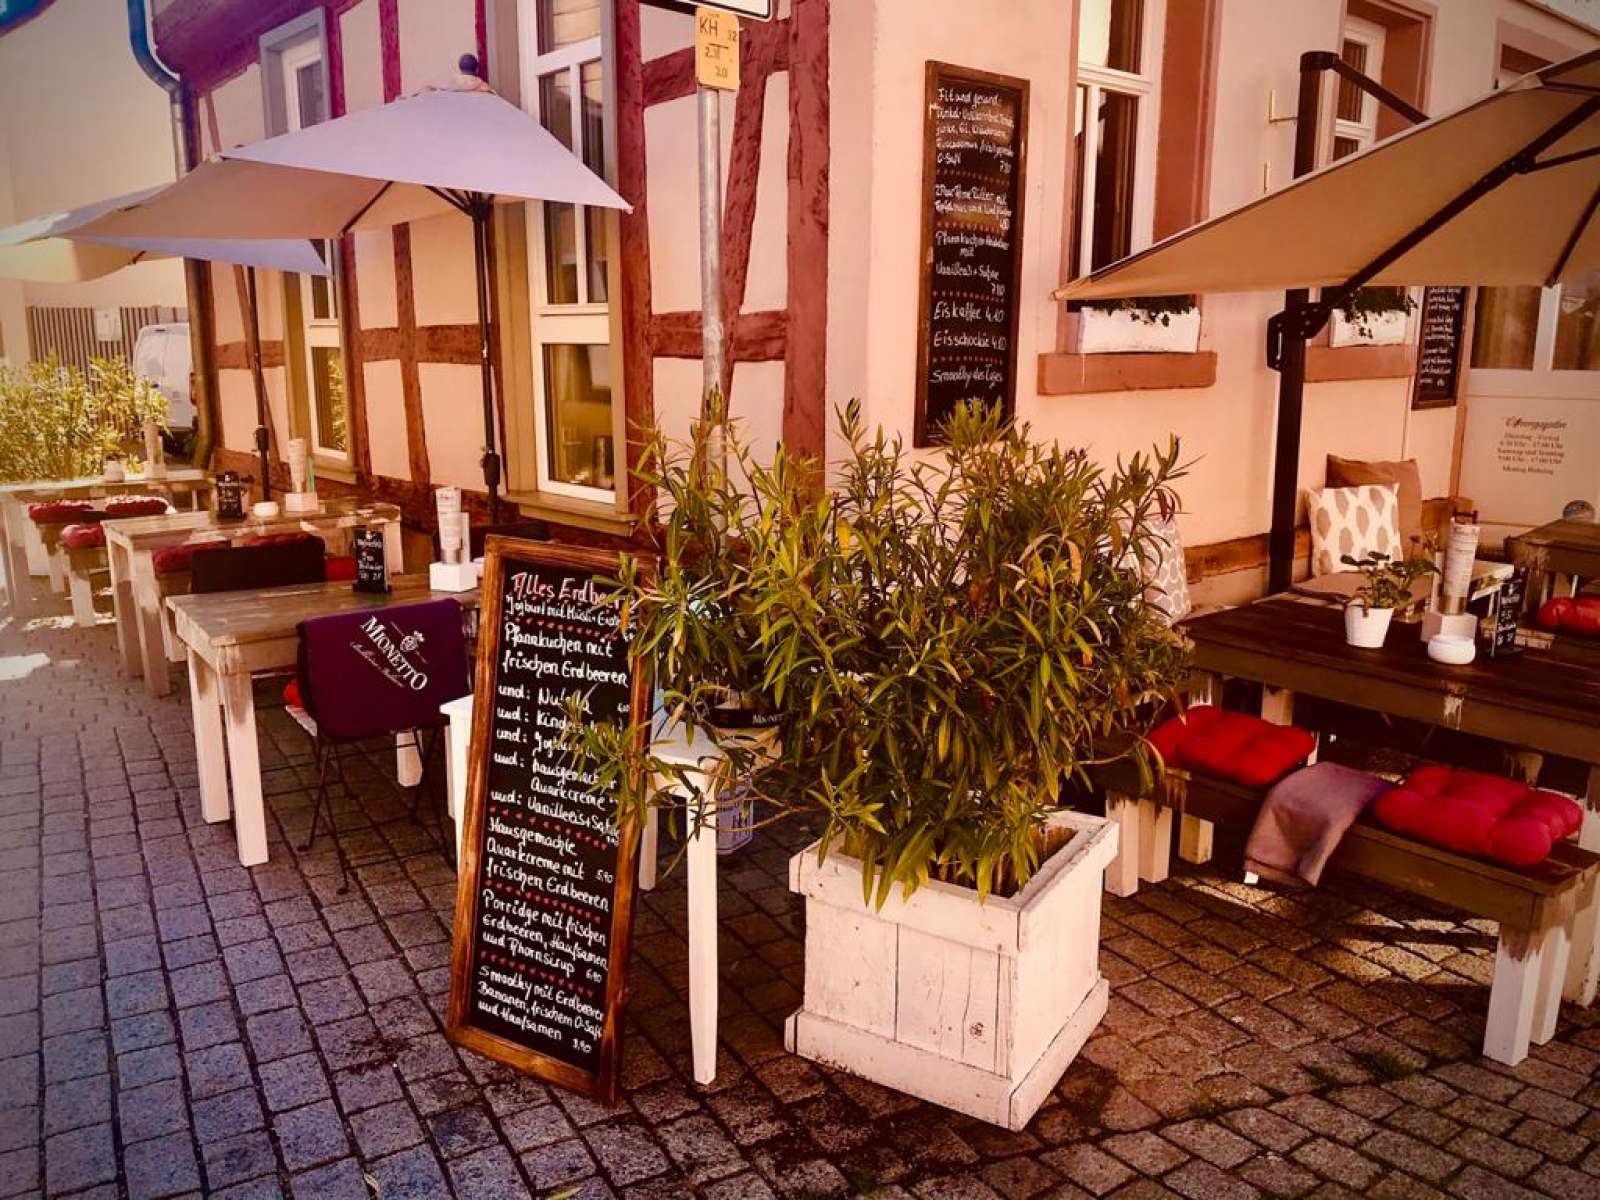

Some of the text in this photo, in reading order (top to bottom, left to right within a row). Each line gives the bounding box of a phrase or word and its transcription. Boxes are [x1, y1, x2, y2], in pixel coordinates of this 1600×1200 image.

[699, 16, 719, 38] KH
[933, 300, 982, 322] Eiskaffee
[510, 572, 556, 600] Alles
[359, 616, 428, 690] MIONETTO
[504, 622, 614, 658] Pfannkuchen mit
[502, 650, 628, 688] frischen Erdbeeren
[499, 684, 530, 700] und:
[496, 706, 530, 724] und:
[496, 728, 528, 744] und:
[494, 752, 525, 768] und:
[490, 789, 523, 804] und:
[527, 796, 586, 826] Vanilleeis
[530, 776, 606, 812] Quarkcreme
[488, 816, 578, 856] Hausgemachte
[486, 836, 560, 876] Quarkcreme
[562, 860, 584, 880] mit
[486, 856, 609, 913] frischen Erdbeeren
[482, 888, 606, 947] Porridge mit frischen
[482, 913, 548, 950] Erdbeeren,
[482, 932, 506, 949] und
[478, 965, 532, 1000] Smoothy
[533, 982, 554, 1001] mit
[478, 1000, 500, 1017] und
[530, 1000, 572, 1027] frischem
